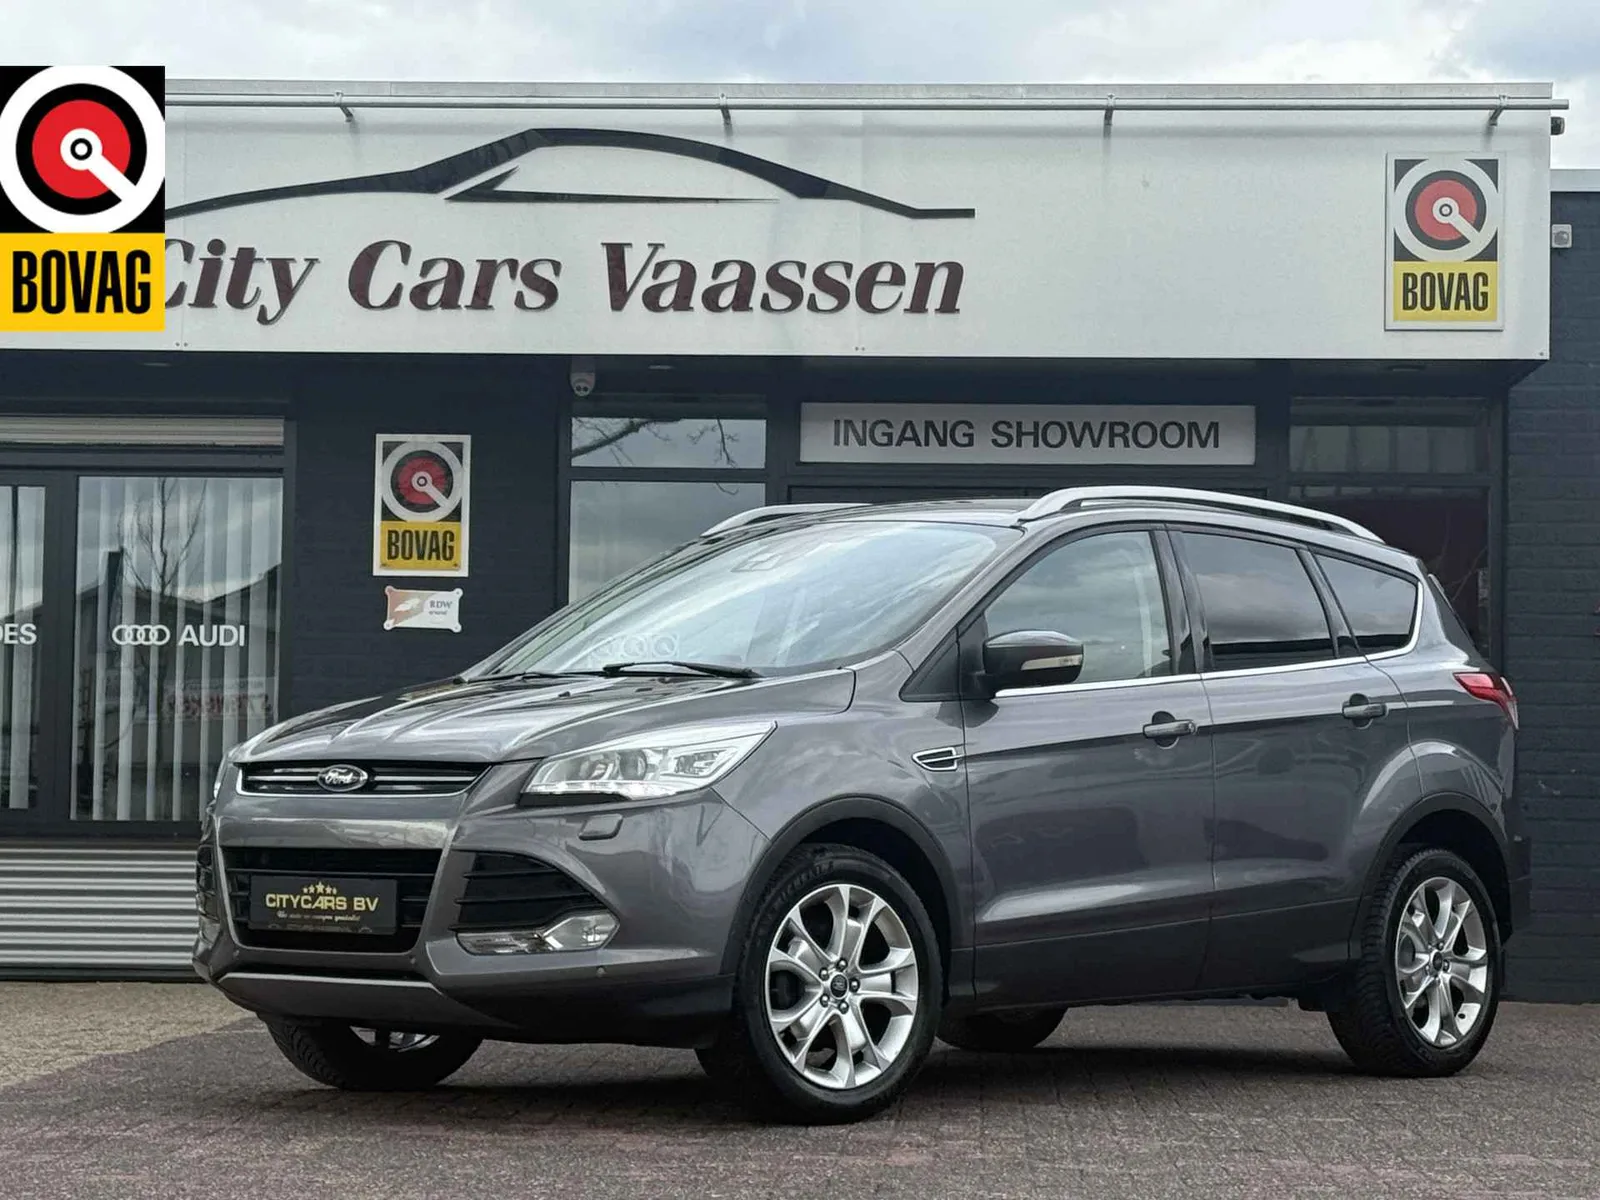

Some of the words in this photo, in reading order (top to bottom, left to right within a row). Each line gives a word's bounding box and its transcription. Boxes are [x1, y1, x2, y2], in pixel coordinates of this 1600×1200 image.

[348, 239, 562, 312] Cars
[600, 242, 964, 314] Vaassen
[1402, 272, 1489, 311] BOVAG
[833, 419, 975, 448] INGANG
[991, 420, 1220, 449] SHOWROOM
[387, 529, 455, 561] BOVAG
[429, 600, 453, 609] RDW
[0, 623, 37, 645] ES
[178, 624, 246, 647] AUDI
[325, 768, 354, 785] Ford
[265, 893, 347, 911] CITYCARS
[353, 897, 379, 912] BV
